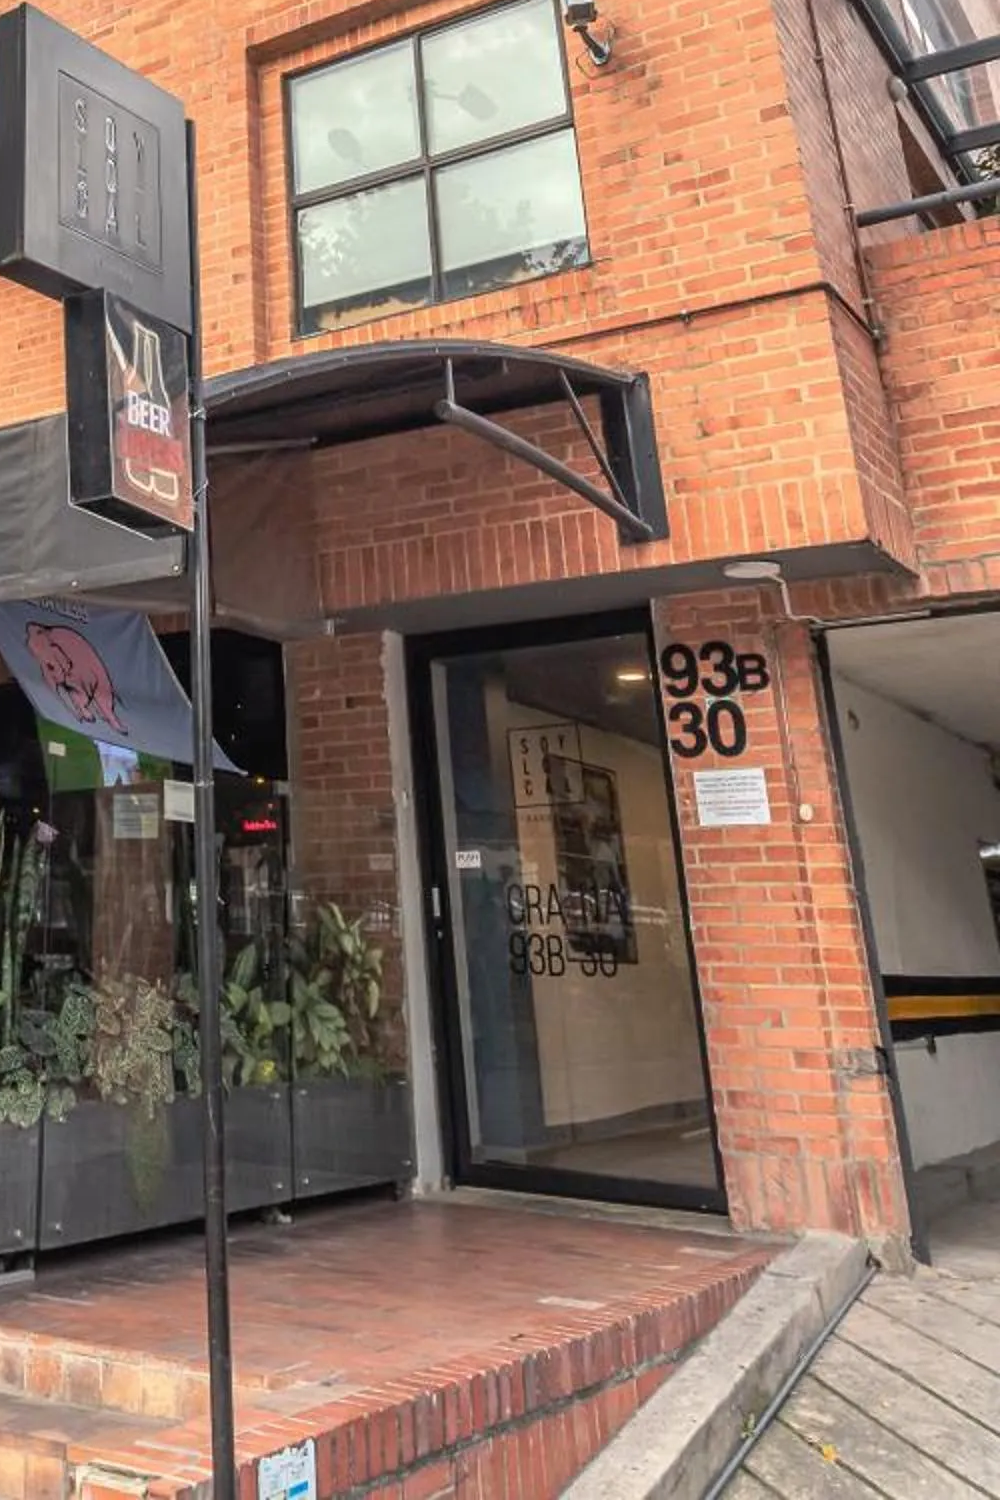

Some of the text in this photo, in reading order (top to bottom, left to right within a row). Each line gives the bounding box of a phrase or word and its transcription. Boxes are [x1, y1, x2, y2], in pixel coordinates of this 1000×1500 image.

[127, 389, 171, 437] BEER
[519, 734, 566, 755] SOY
[669, 701, 747, 758] 30
[507, 883, 568, 925] CRA
